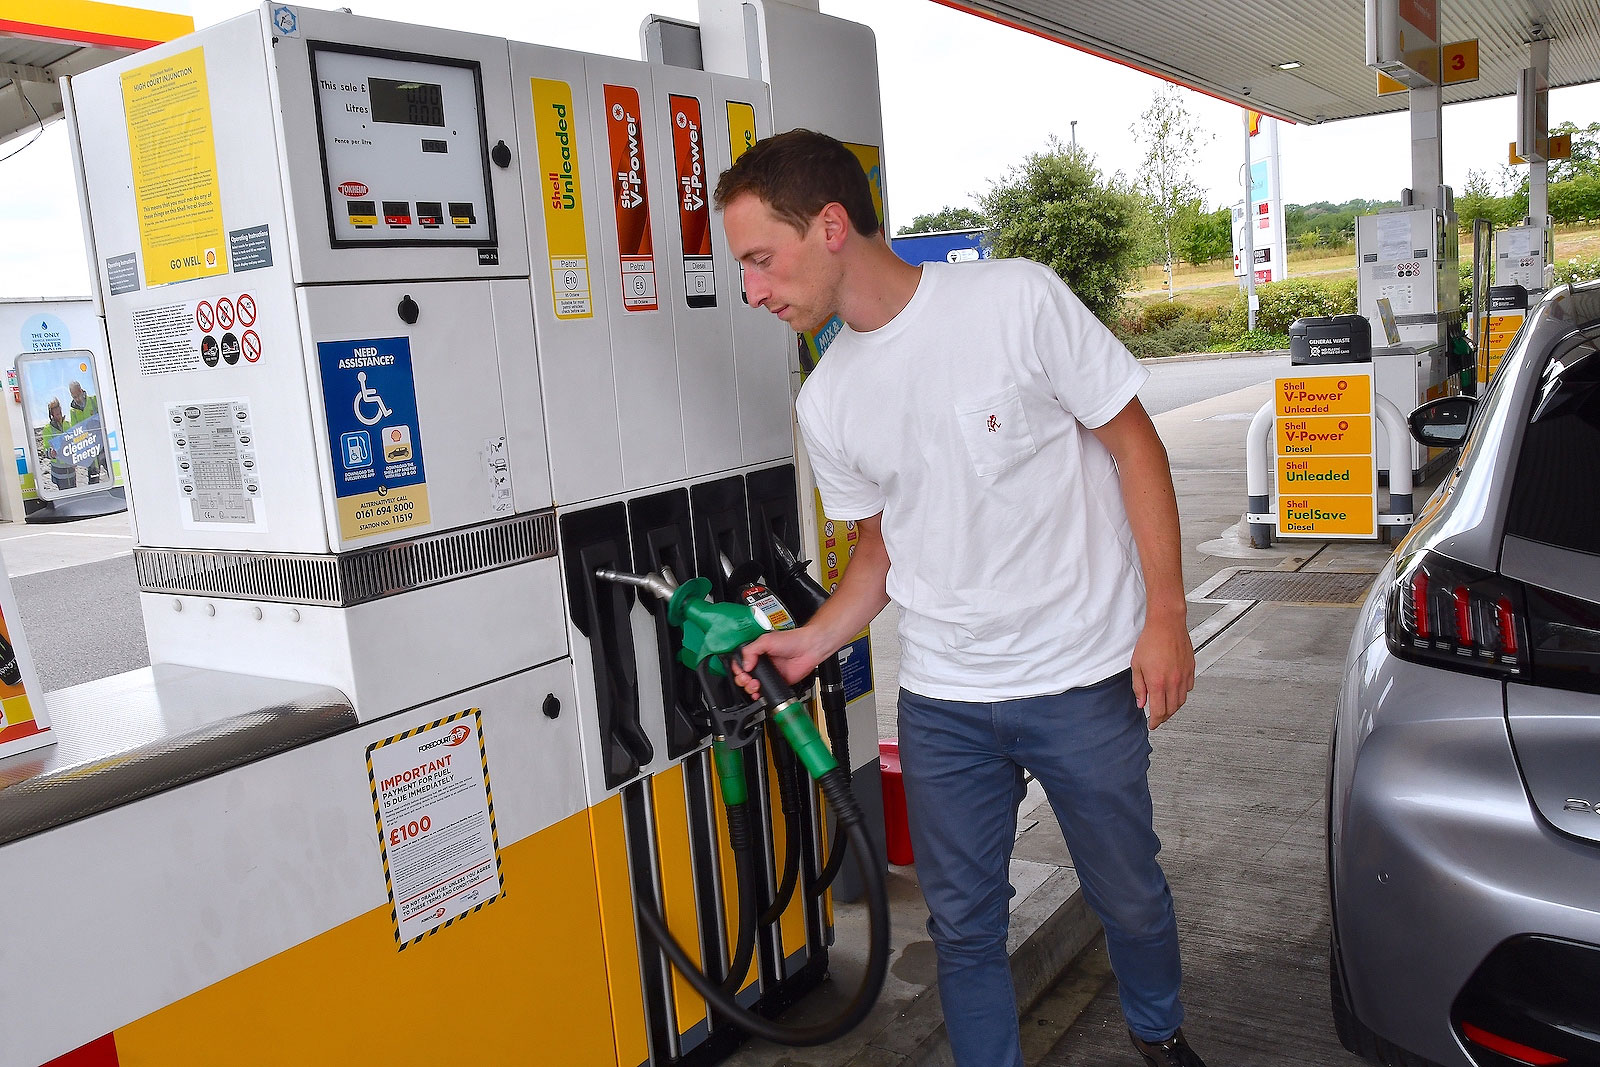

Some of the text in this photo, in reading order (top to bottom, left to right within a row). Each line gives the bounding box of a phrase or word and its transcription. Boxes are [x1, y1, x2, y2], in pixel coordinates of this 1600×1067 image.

[1452, 54, 1465, 70] 3
[134, 82, 146, 92] HIGH
[146, 77, 162, 88] COURT
[162, 67, 192, 82] INJUNCTION
[320, 80, 366, 92] This sale £
[346, 104, 369, 114] Litres
[552, 104, 576, 210] Unleaded
[626, 112, 643, 208] V-Power
[689, 120, 704, 210] V-Power
[549, 172, 562, 210] Shell
[618, 172, 630, 208] Shell
[682, 176, 692, 211] Shell
[170, 255, 201, 269] GO WELL
[818, 326, 833, 349] MIX
[832, 321, 840, 333] &
[339, 355, 394, 368] ASSISTANCE?
[354, 348, 377, 358] NEED
[1284, 382, 1305, 390] Shell
[1284, 392, 1343, 401] V-Power
[1284, 404, 1329, 413] Unleaded
[73, 426, 84, 436] UK
[1285, 422, 1306, 430] Shell
[62, 434, 97, 456] Cleaner
[1286, 432, 1344, 441] V-Power
[72, 444, 101, 464] Energy
[1286, 470, 1350, 481] Unleaded
[356, 502, 414, 519] 0161 694 8000
[361, 497, 395, 509] ALTERNATIVELY
[360, 522, 380, 530] STATION
[392, 513, 413, 523] 11519
[1287, 509, 1346, 520] FuelSave
[418, 736, 452, 752] FORECOURT
[380, 754, 452, 792] IMPORTANT
[383, 768, 451, 800] PAYMENT FOR FUEL
[384, 775, 455, 809] IS DUE IMMEDIATELY
[390, 815, 431, 846] £100
[421, 892, 436, 902] DRAW
[437, 886, 448, 894] FUEL
[449, 876, 466, 887] UNLESS
[466, 871, 476, 879] YOU
[476, 864, 491, 874] AGREE
[411, 903, 425, 913] THESE
[426, 895, 441, 905] TERMS
[453, 875, 480, 892] CONDITIONS
